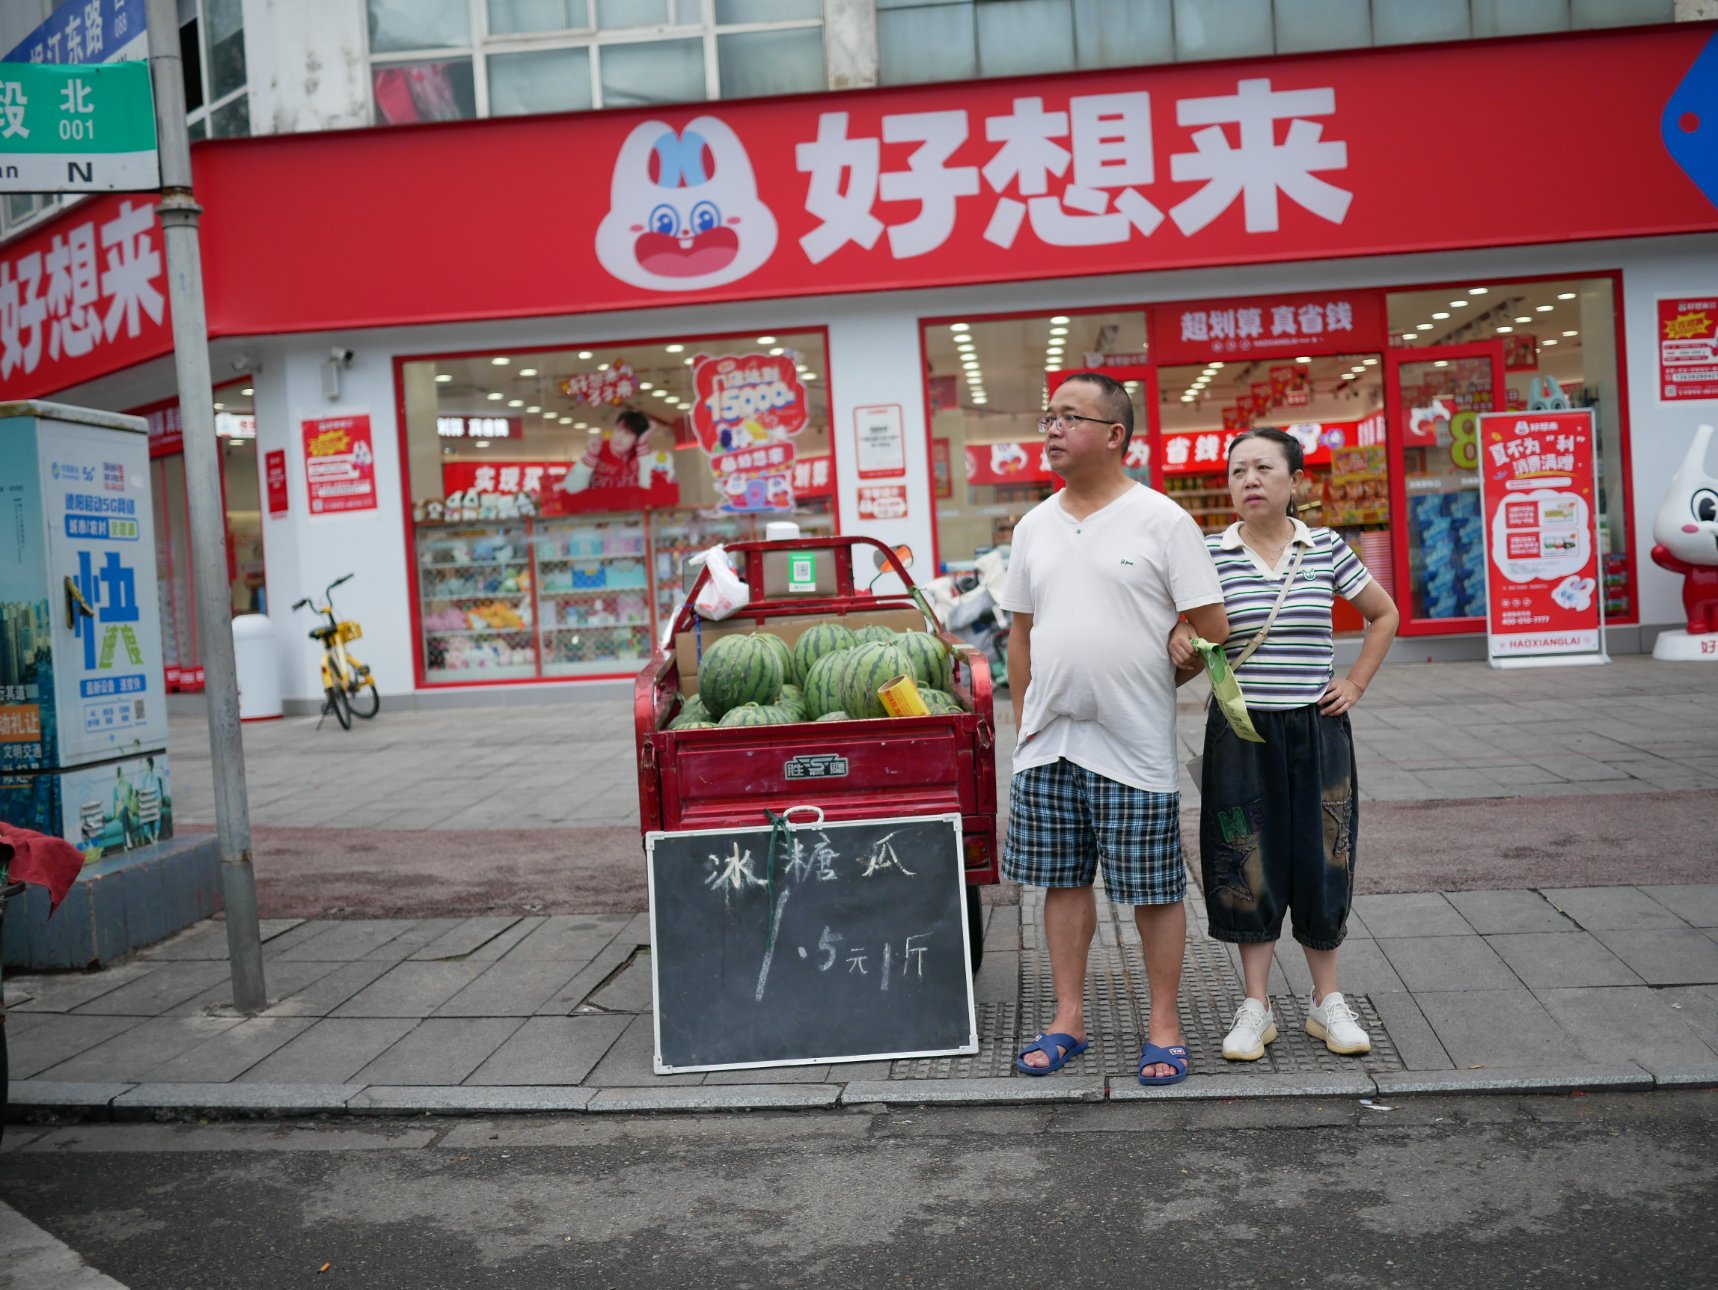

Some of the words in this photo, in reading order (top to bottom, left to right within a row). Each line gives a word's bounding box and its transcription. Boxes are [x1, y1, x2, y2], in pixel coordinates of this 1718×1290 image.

[60, 78, 95, 114] 北
[59, 119, 94, 141] 001
[67, 162, 93, 182] N
[795, 78, 1353, 265] 好想来
[0, 201, 165, 382] 好想来
[1181, 308, 1263, 342] 超划算
[1270, 301, 1353, 336] 真省钱
[1165, 433, 1230, 465] 省钱
[1509, 637, 1580, 649] HAOXIANGLAI
[1701, 640, 1716, 654] 好
